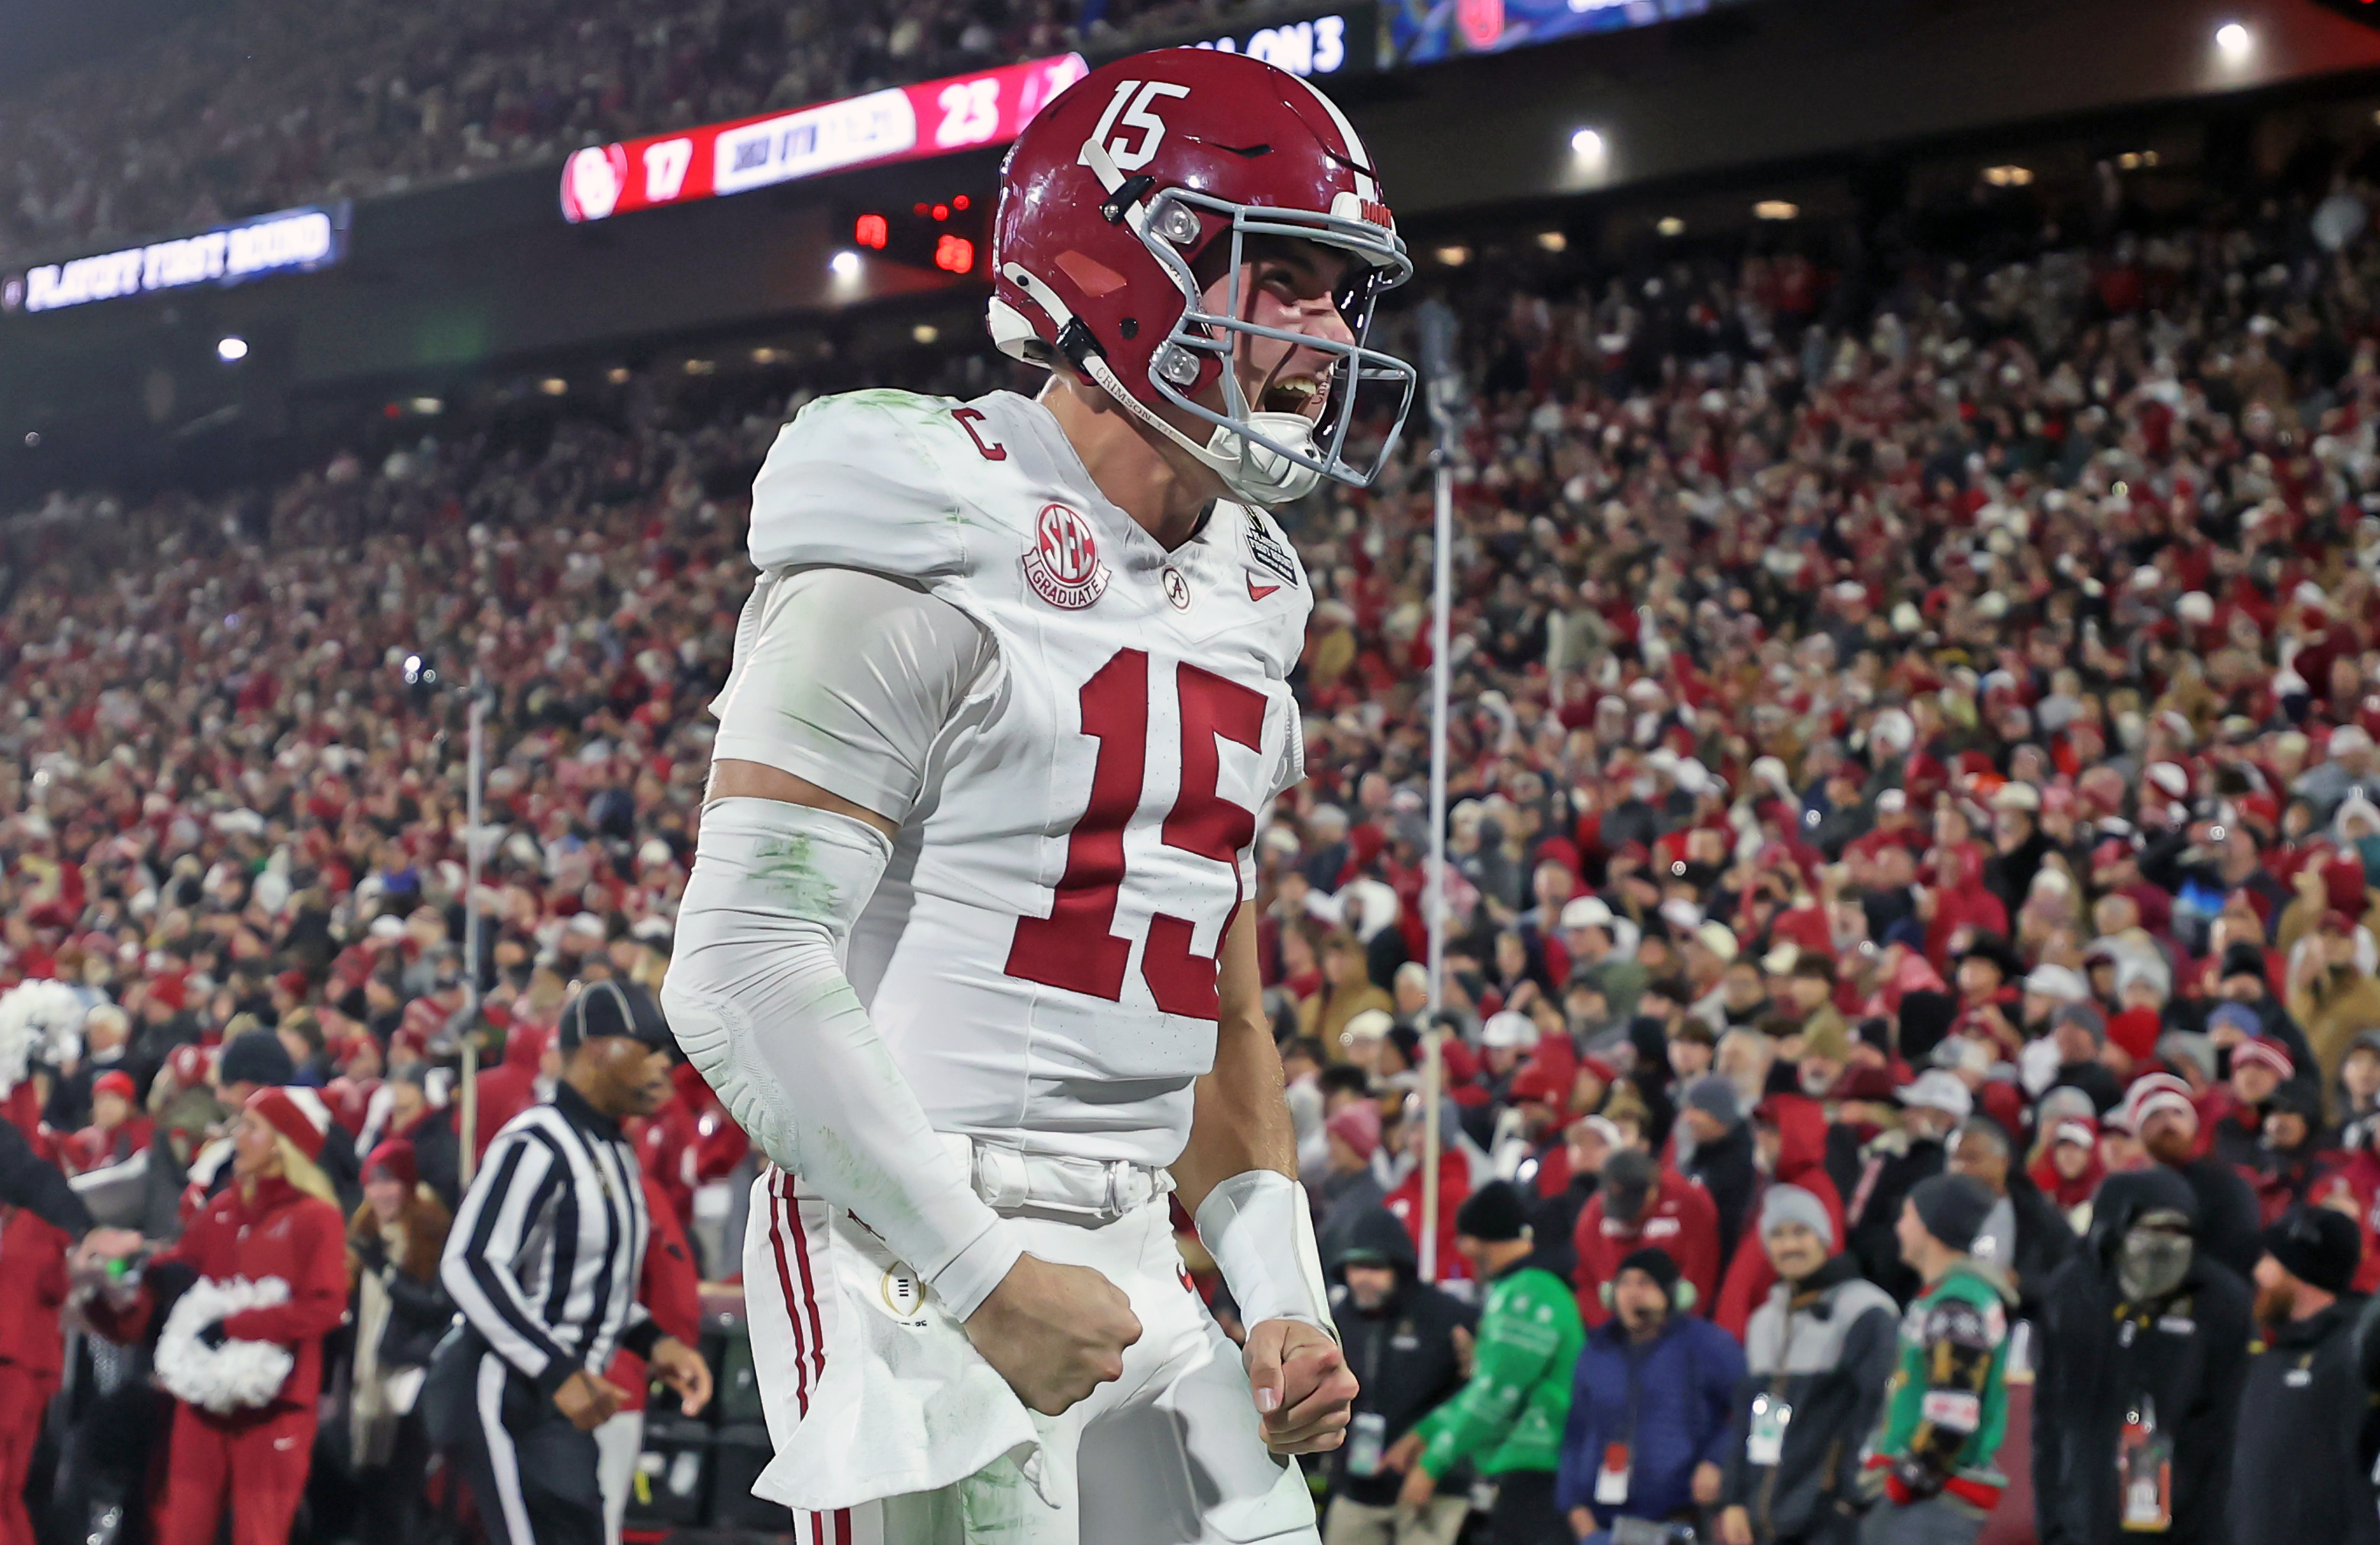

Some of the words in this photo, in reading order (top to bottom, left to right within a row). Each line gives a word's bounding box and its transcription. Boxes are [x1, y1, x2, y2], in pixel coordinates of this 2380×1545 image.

[1313, 15, 1344, 73] 3
[644, 137, 692, 202] 17
[935, 76, 998, 148] 23
[1076, 80, 1191, 171] 15
[1096, 366, 1151, 421] CRIMSON
[951, 407, 1007, 461] C
[1041, 508, 1093, 579] SEC
[1032, 570, 1102, 605] GRADUATE
[1004, 646, 1269, 1022] 15
